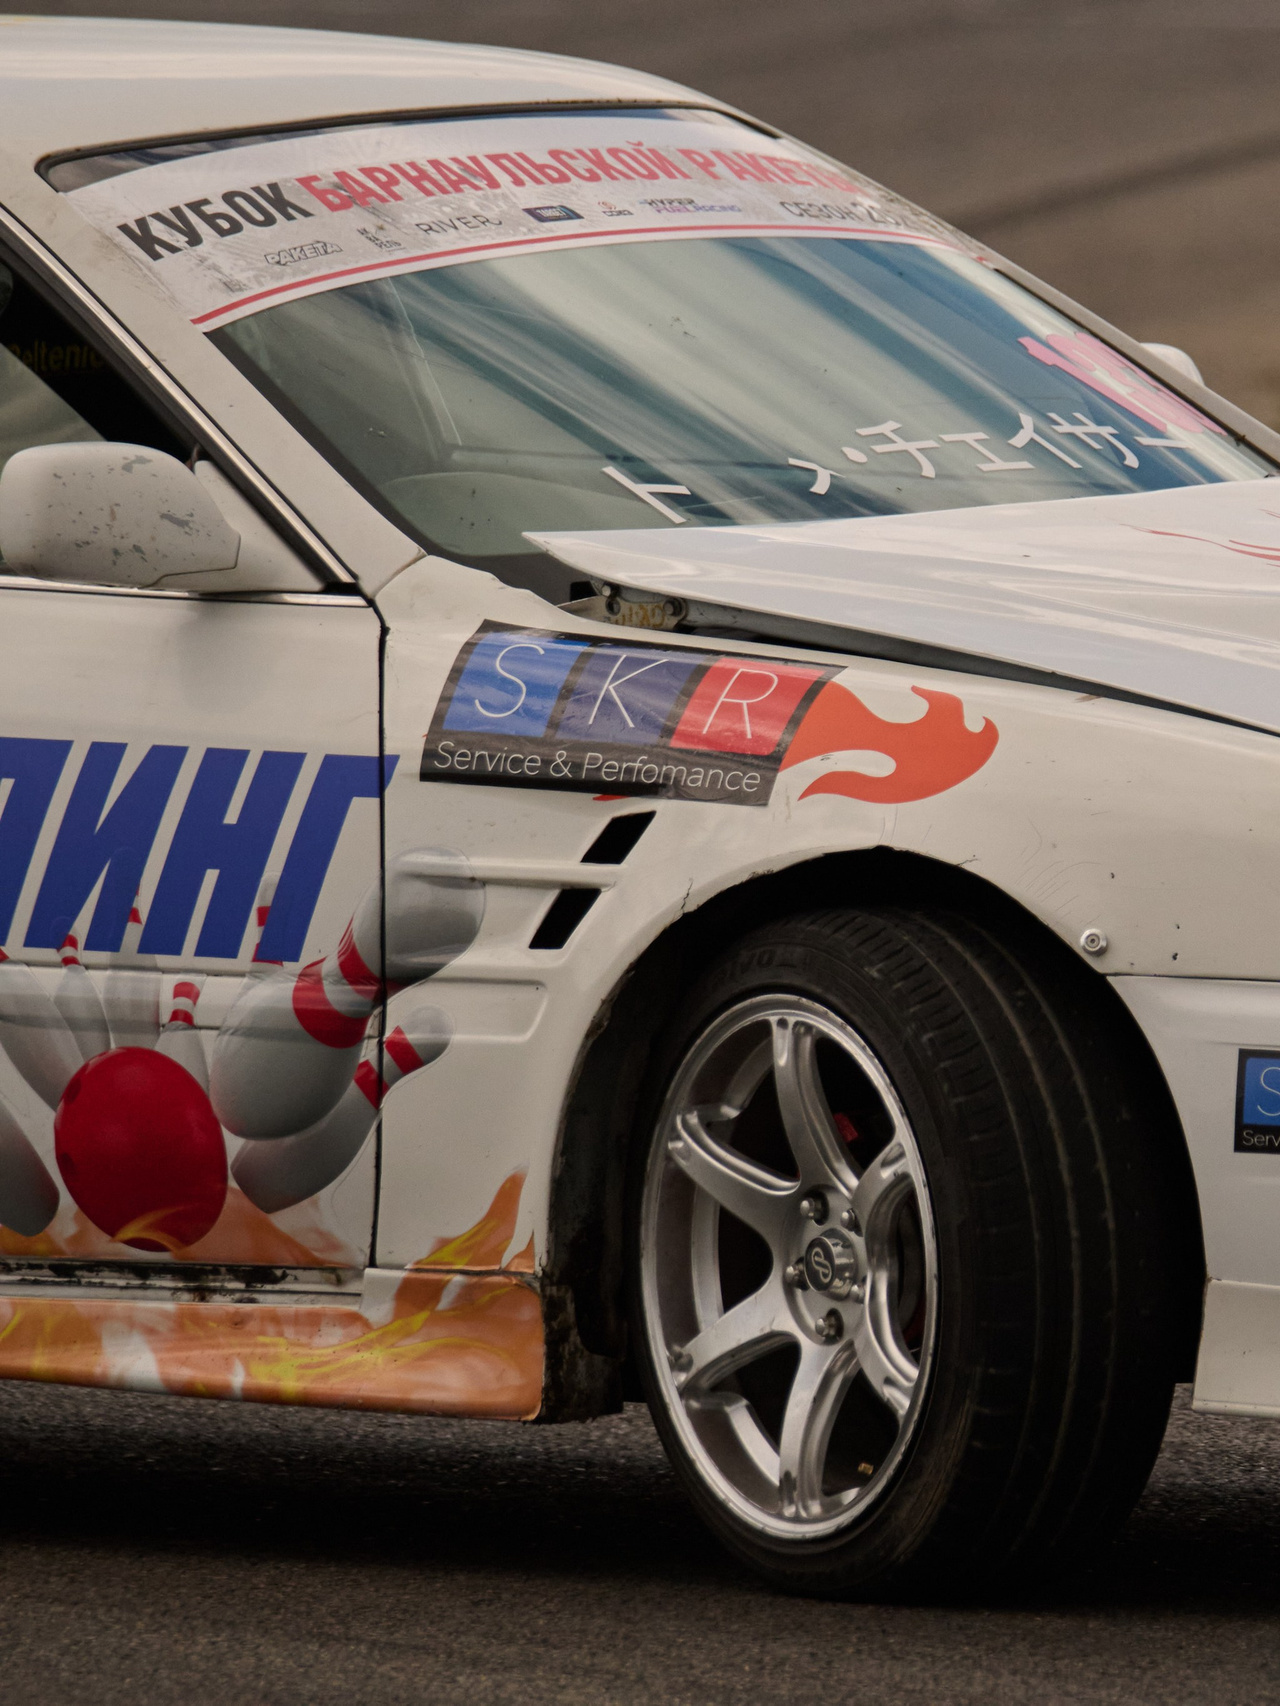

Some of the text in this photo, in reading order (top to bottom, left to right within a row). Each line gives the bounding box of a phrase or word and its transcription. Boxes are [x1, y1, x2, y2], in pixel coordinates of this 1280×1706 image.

[116, 182, 315, 262] КУБОК
[295, 141, 691, 213] БАРНАУЛЬСКОЙ
[415, 214, 503, 236] RIVER
[474, 643, 780, 739] SKR
[433, 740, 762, 793] Service & Perfomance
